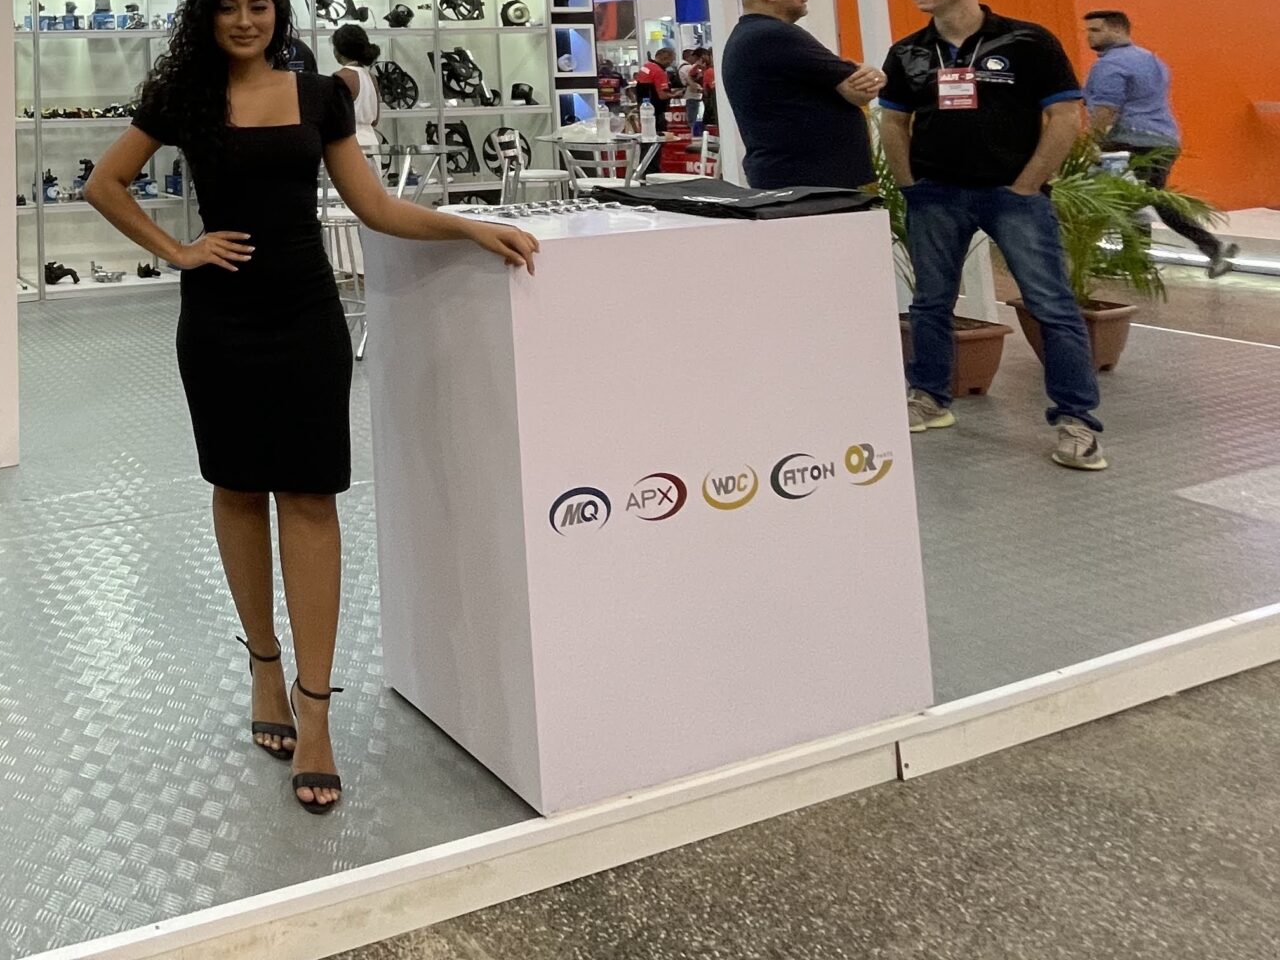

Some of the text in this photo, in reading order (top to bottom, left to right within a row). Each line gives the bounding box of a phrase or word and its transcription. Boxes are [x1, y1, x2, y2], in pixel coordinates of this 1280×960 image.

[711, 473, 748, 496] WDC
[783, 462, 835, 487] ATON
[625, 485, 674, 512] APX
[561, 499, 598, 527] MQ
